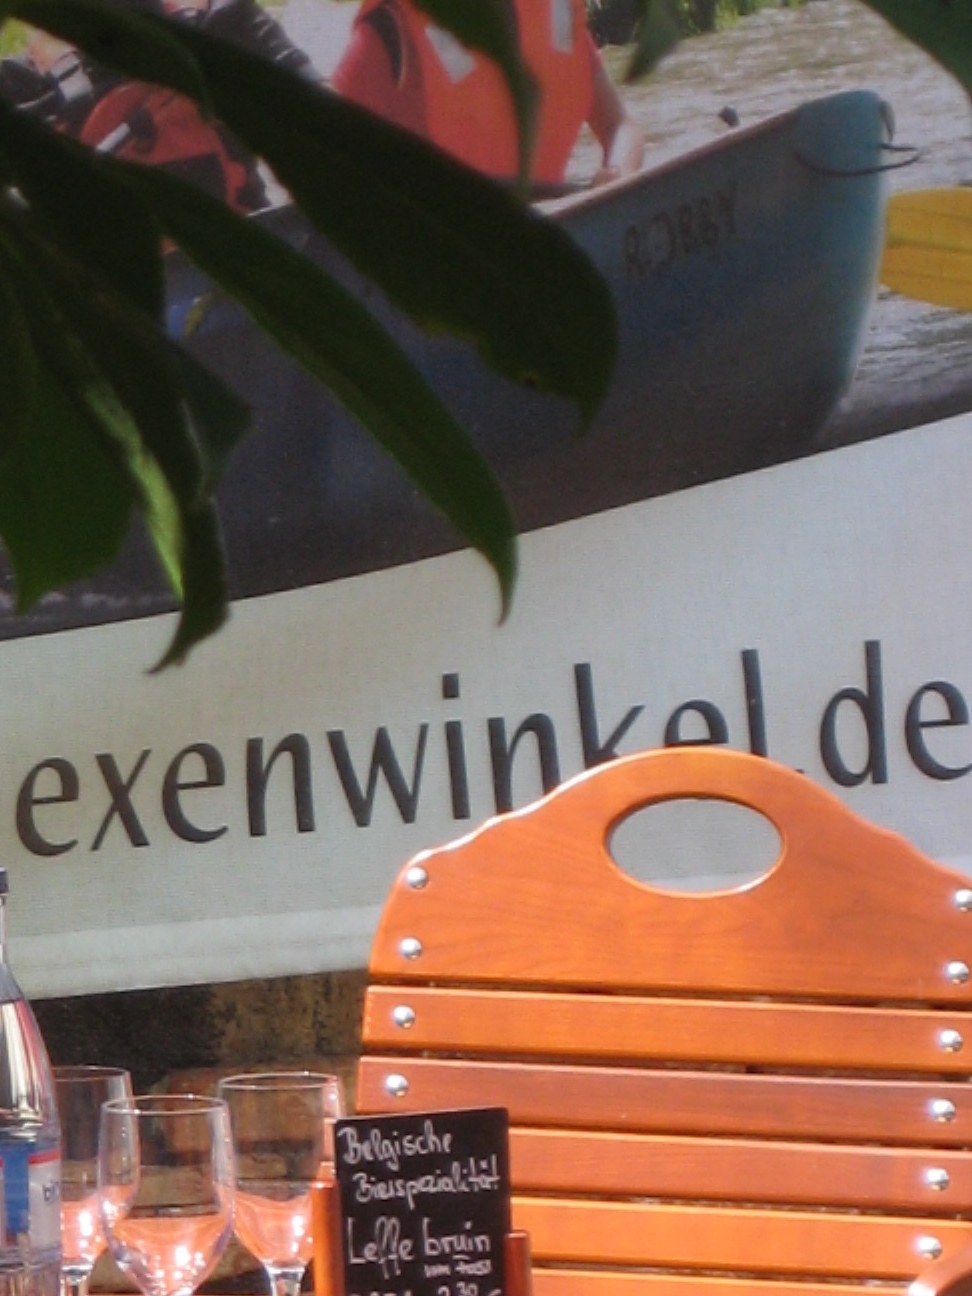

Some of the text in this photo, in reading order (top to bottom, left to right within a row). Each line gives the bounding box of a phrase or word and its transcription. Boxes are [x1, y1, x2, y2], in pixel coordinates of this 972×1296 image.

[337, 1118, 452, 1171] Belgische
[347, 1216, 491, 1280] Leffe bruin
